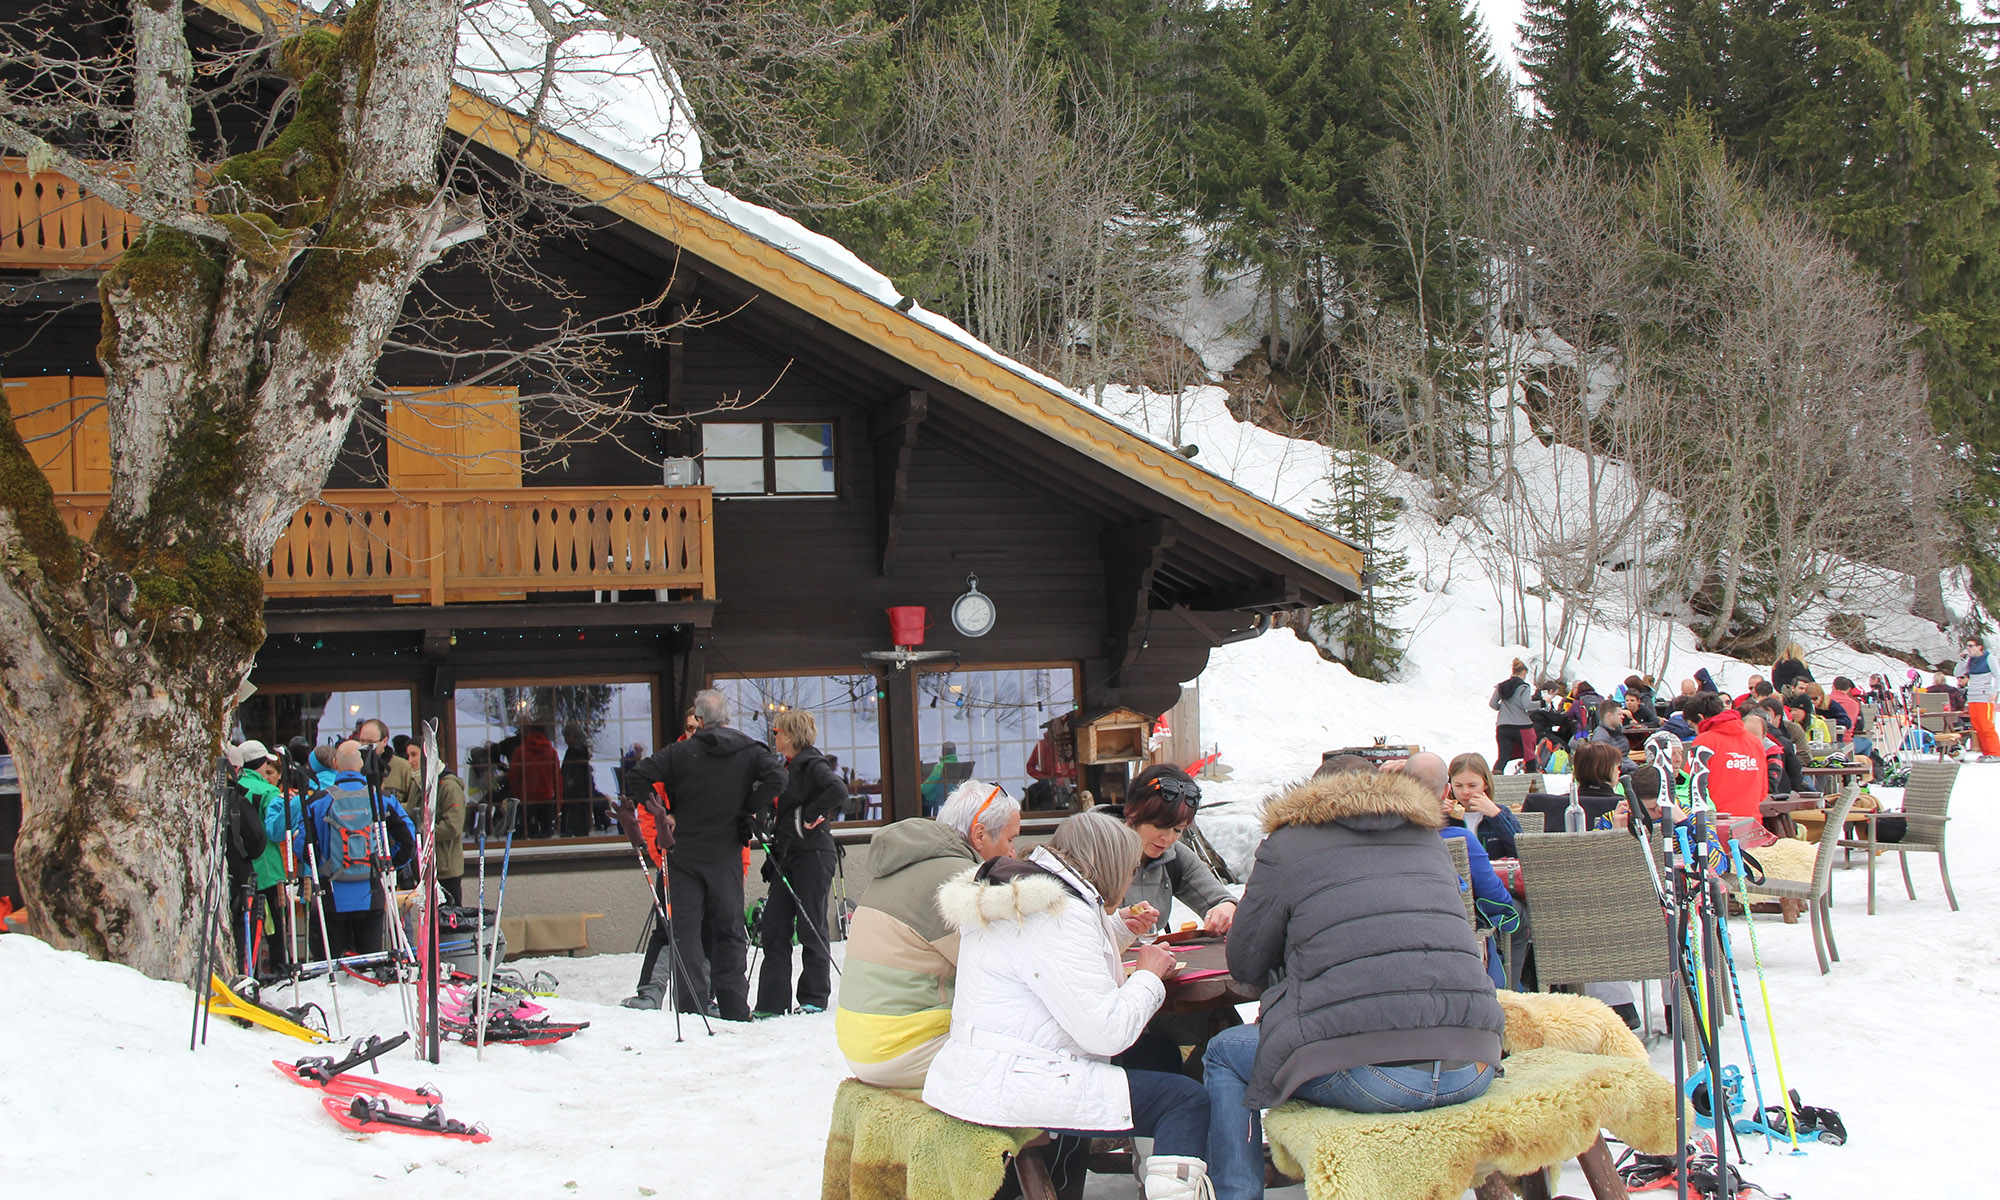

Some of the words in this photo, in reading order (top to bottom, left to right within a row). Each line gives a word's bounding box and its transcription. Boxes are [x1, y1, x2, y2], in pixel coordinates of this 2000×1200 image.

[1726, 755, 1757, 771] eagle
[1692, 786, 1700, 807] LEKI
[638, 856, 650, 875] LEKI
[1664, 866, 1675, 916] LEKI
